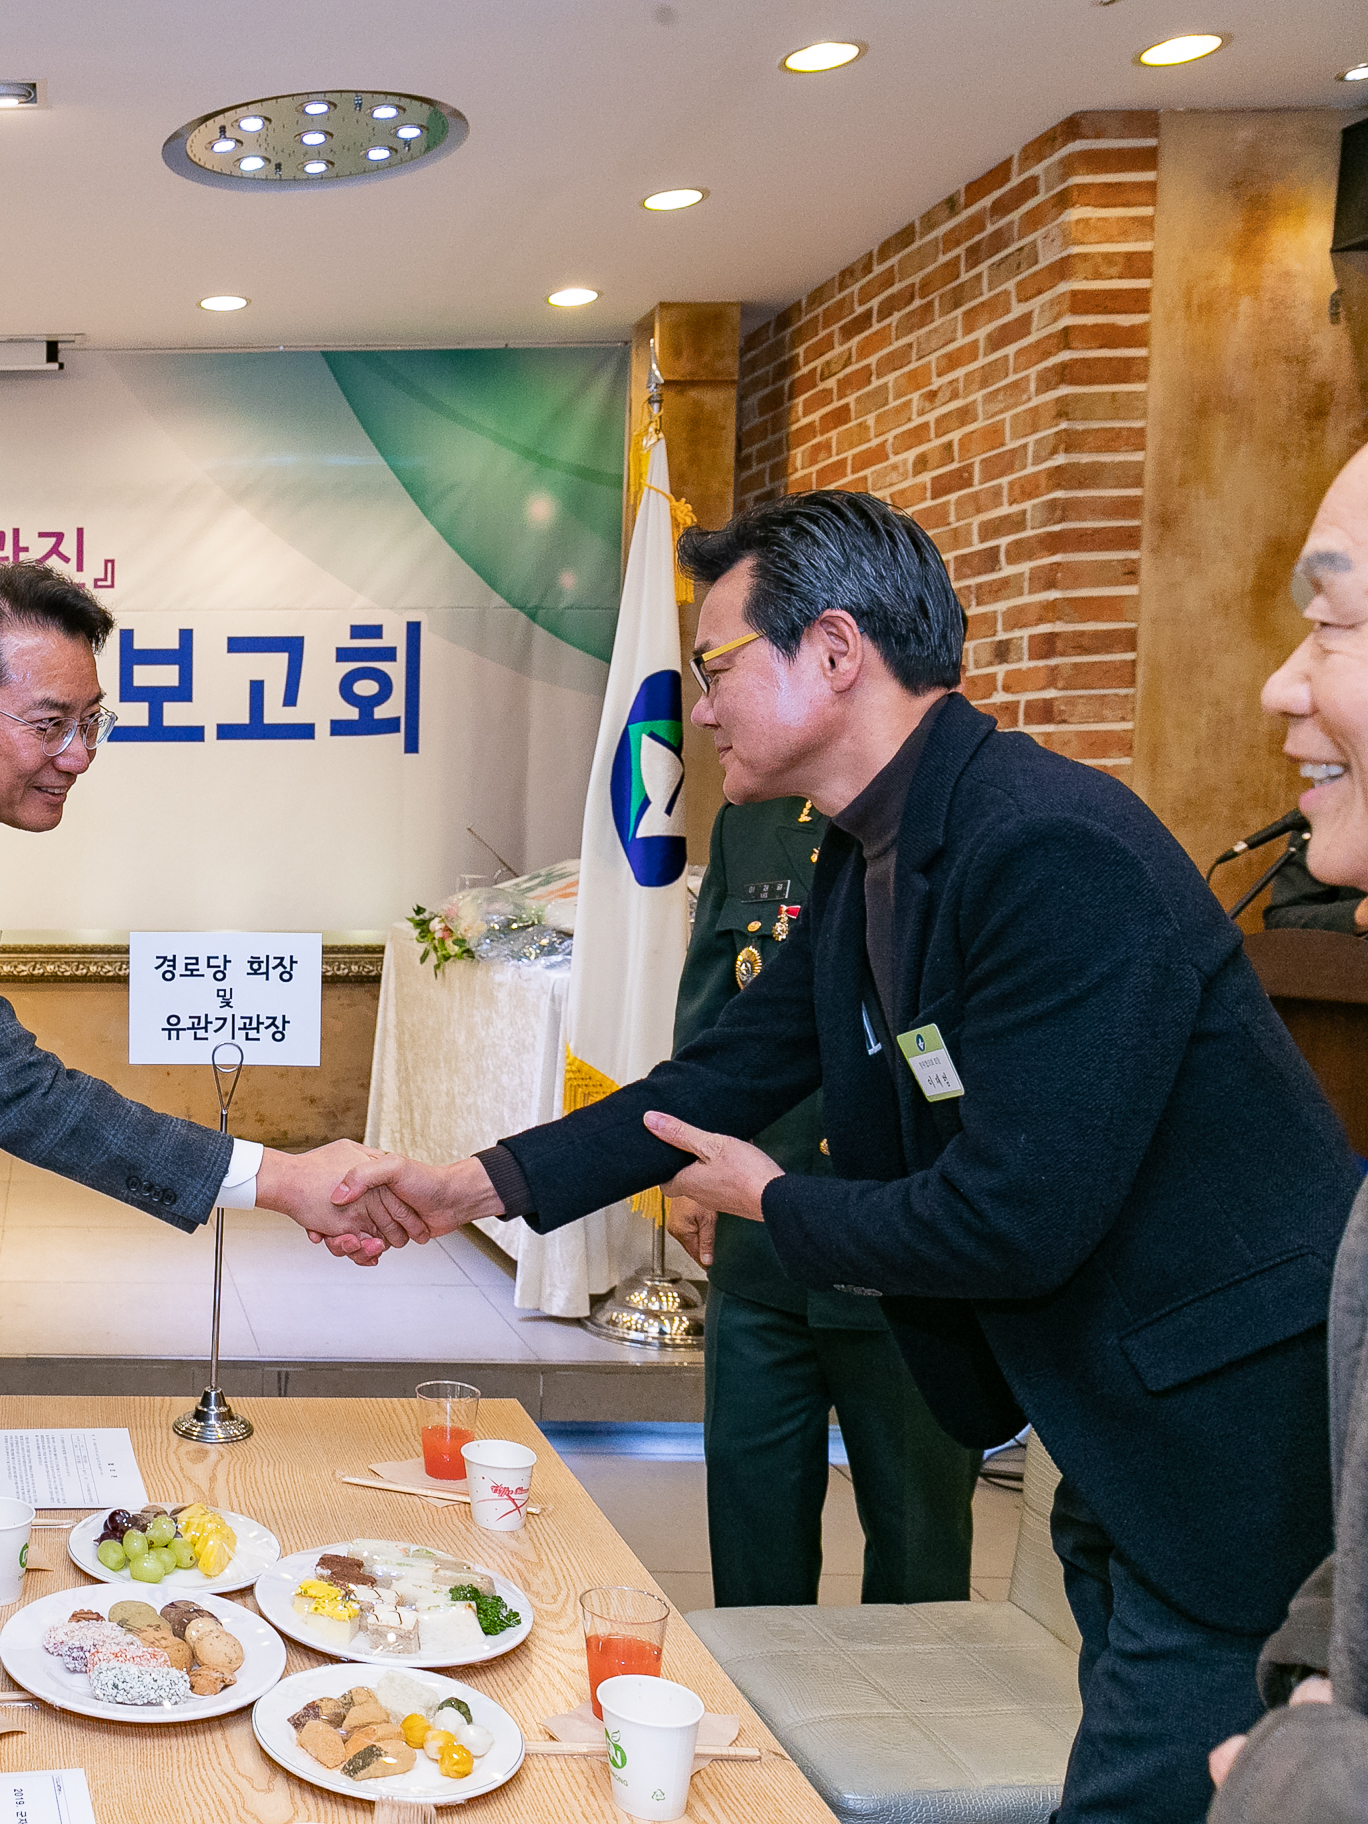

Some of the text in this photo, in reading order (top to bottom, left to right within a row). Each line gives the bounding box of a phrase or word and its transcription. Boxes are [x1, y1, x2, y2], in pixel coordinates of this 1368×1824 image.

[154, 954, 298, 983] 경로당 회장
[216, 987, 234, 1009] 및
[161, 1013, 291, 1043] 유관기관장
